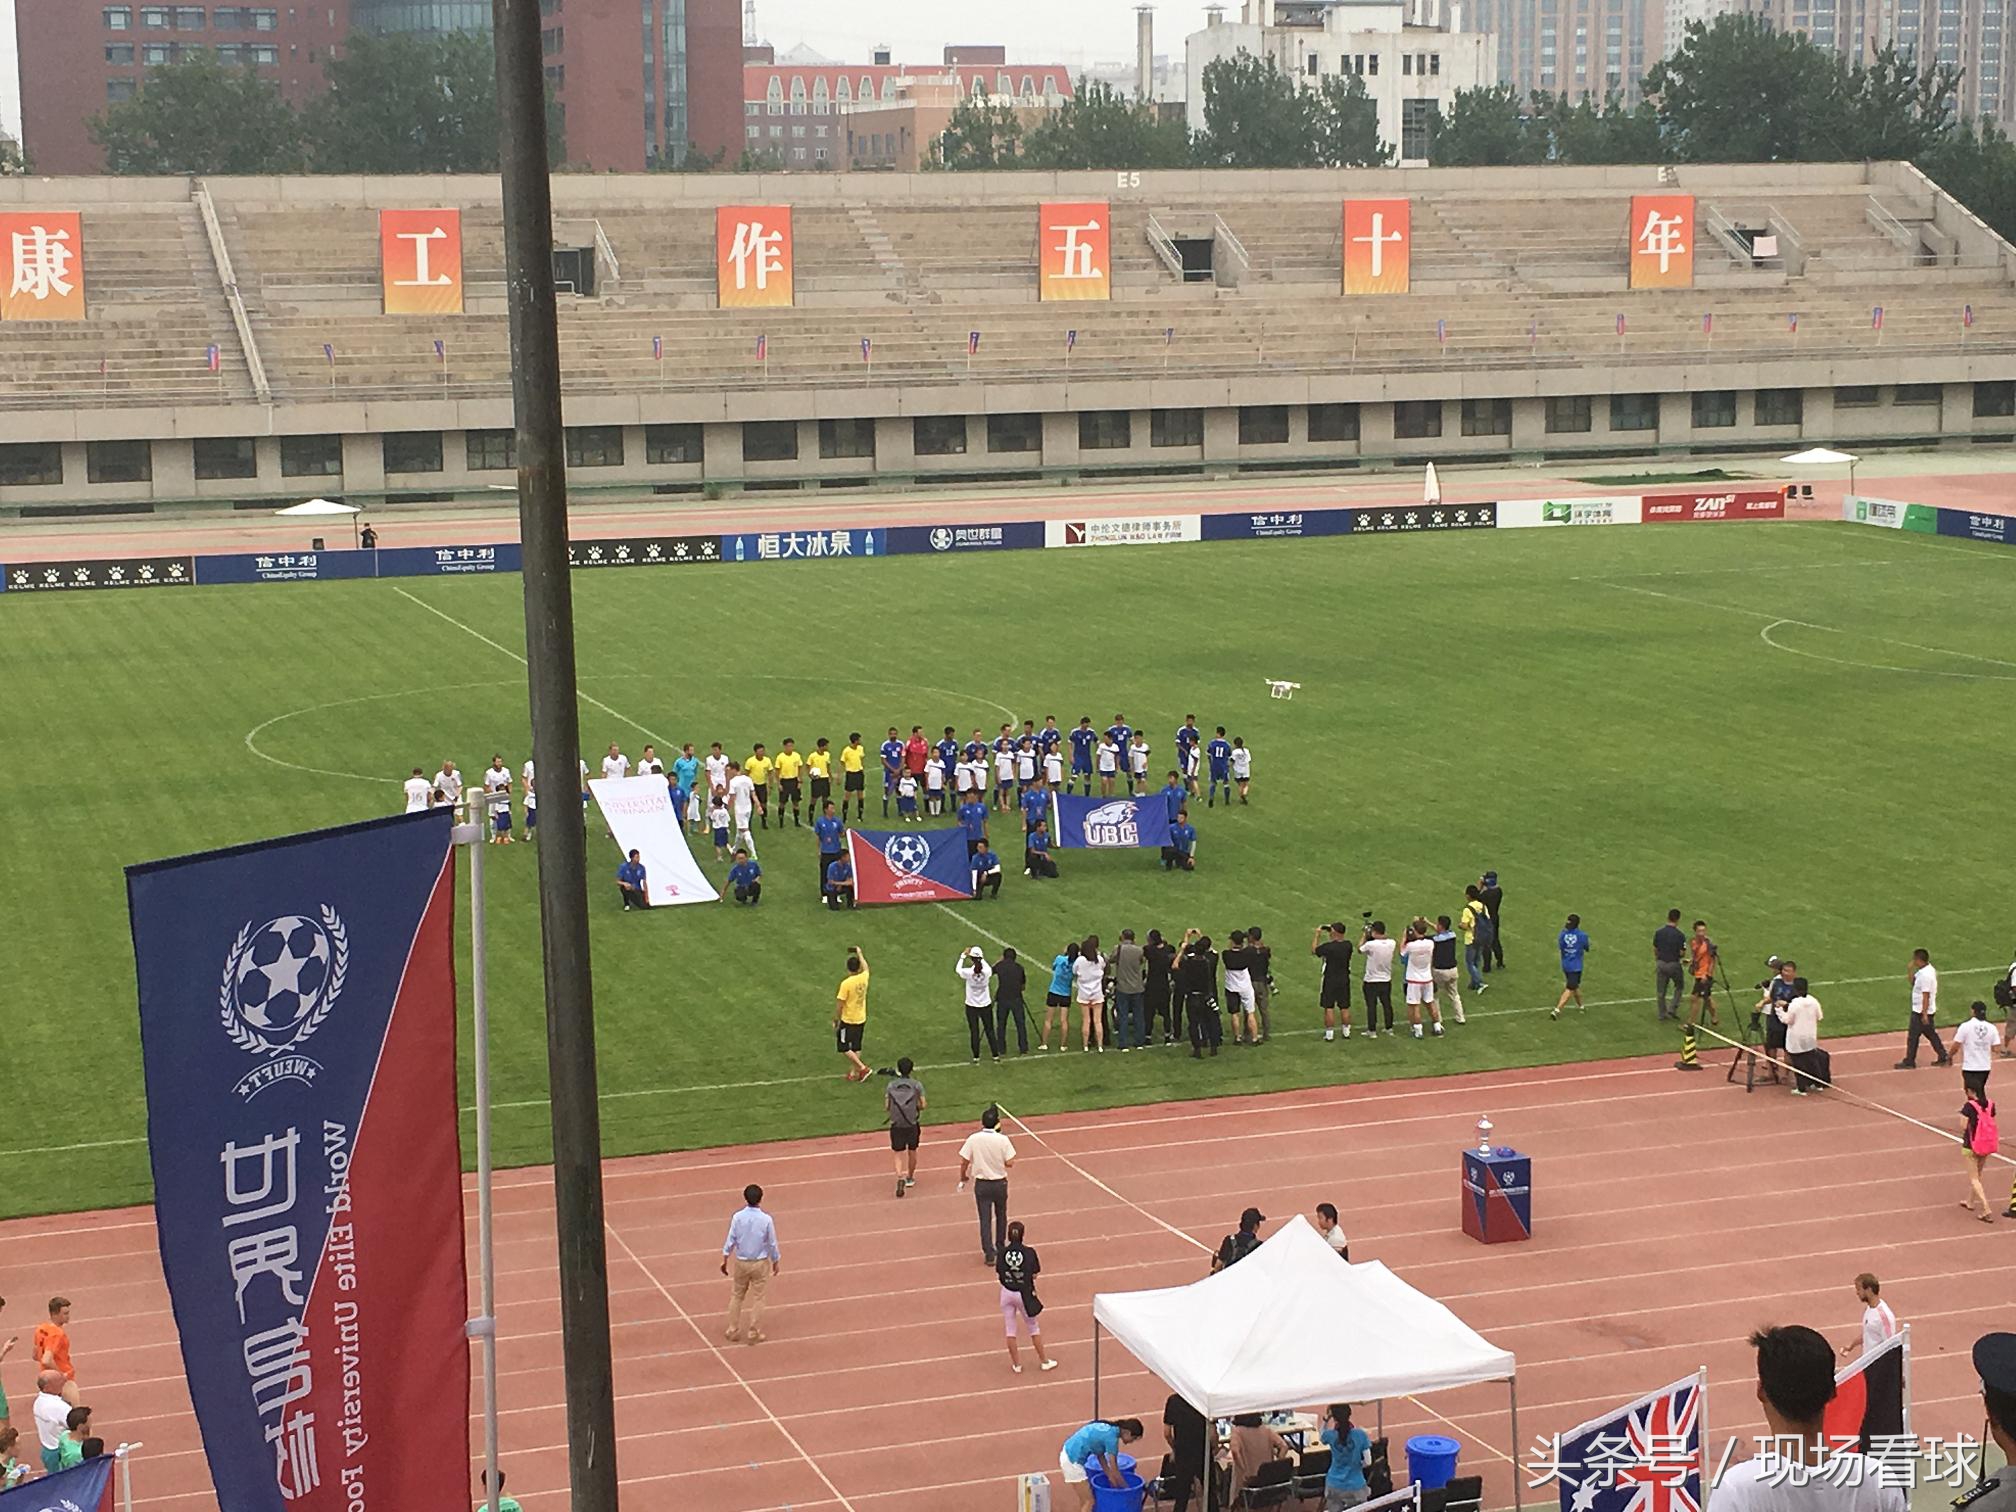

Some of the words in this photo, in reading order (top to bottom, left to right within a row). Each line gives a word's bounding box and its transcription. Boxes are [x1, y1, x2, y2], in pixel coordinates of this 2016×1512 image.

[1117, 172, 1140, 188] E5
[10, 225, 74, 300] 康
[393, 227, 452, 286] 工
[727, 221, 784, 290] 作
[1048, 219, 1104, 279] 五
[1352, 212, 1403, 277] 十
[1637, 210, 1686, 274] 年
[1090, 520, 1182, 534] 中伦文德律师事务所
[1251, 513, 1303, 526] 信中利
[758, 530, 852, 559] 恒大冰泉
[255, 554, 317, 568] 信中利
[436, 547, 495, 561] 信中利
[1083, 821, 1139, 846] UBC
